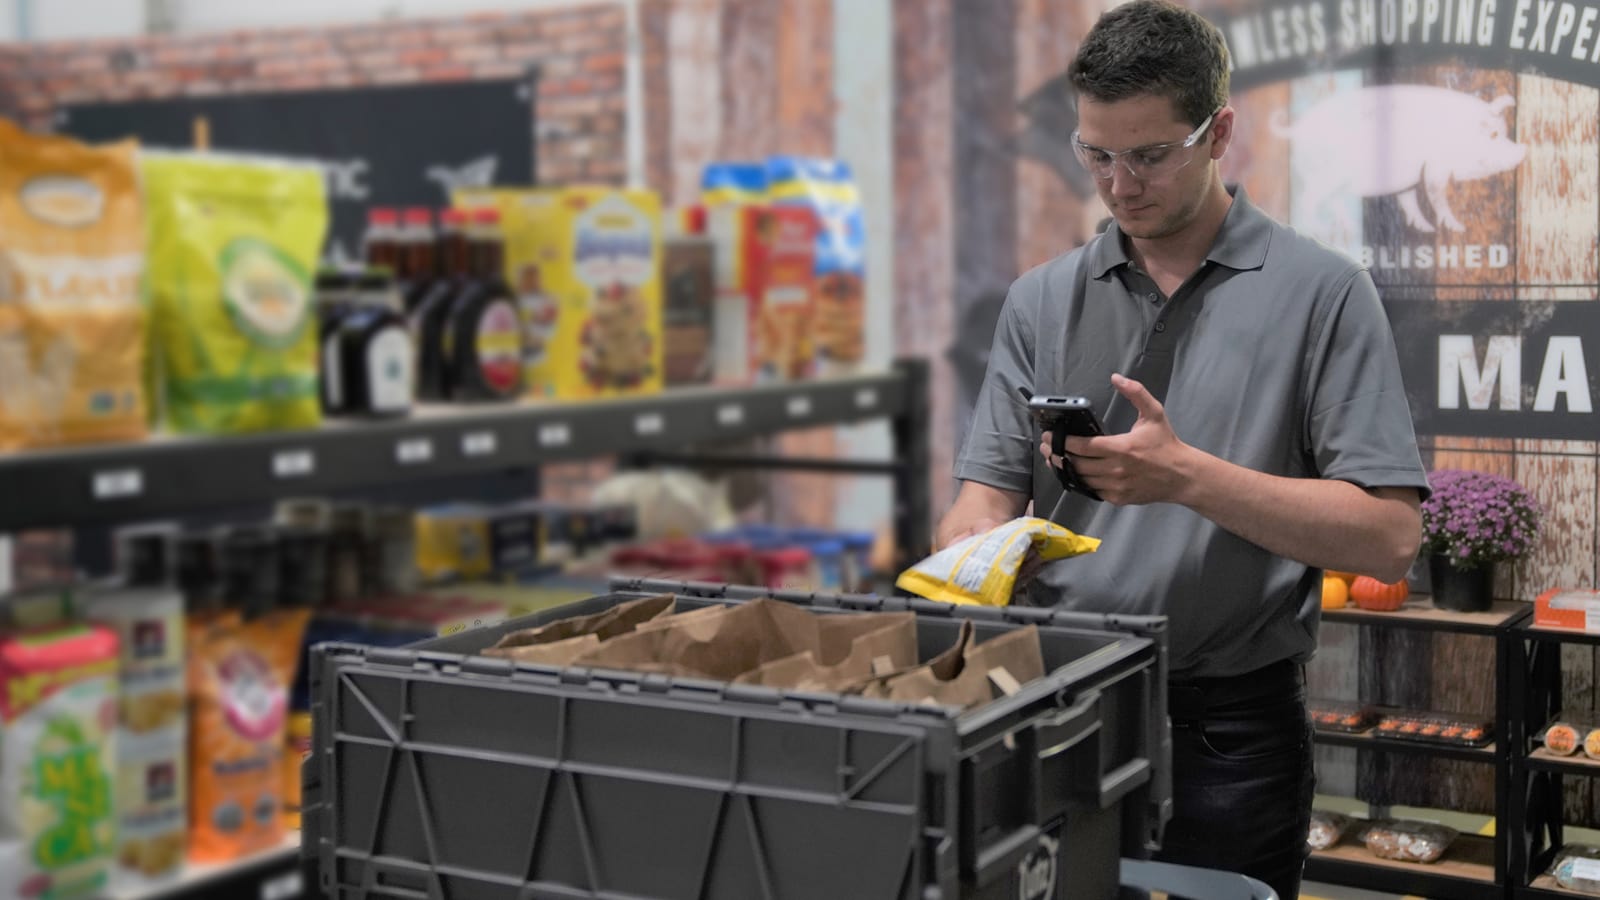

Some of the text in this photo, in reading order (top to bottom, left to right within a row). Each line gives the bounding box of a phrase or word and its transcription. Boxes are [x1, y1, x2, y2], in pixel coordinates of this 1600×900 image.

[1340, 0, 1497, 48] SHOPPING
[1510, 0, 1600, 64] EXPE
[1357, 244, 1509, 269] BLISHED
[1438, 334, 1592, 413] MA
